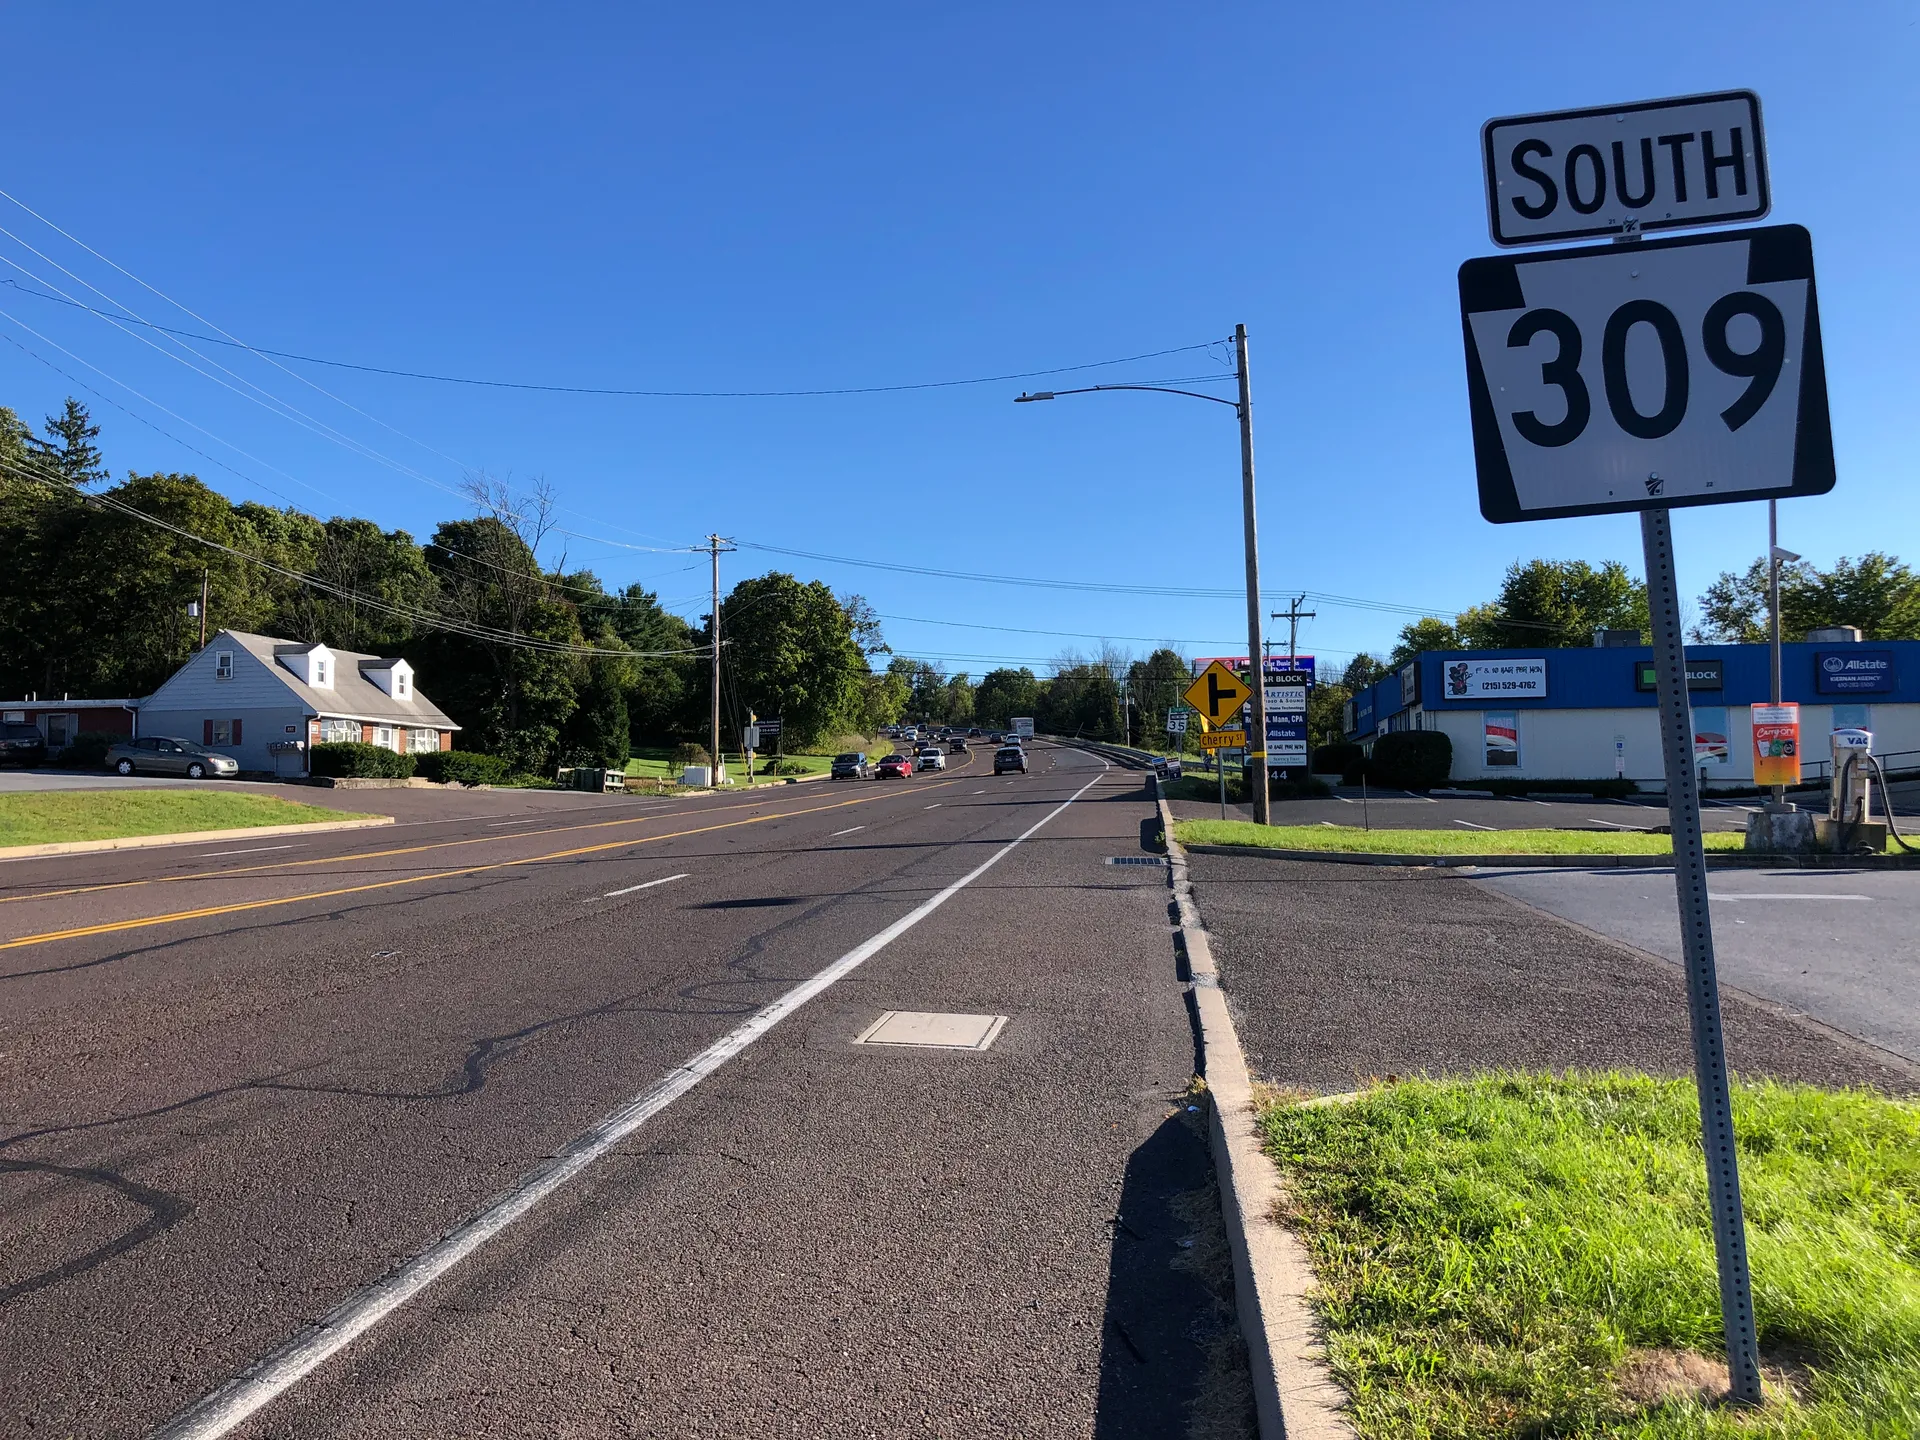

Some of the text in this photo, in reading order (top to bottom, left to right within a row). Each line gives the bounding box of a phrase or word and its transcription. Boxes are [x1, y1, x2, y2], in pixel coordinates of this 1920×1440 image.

[1510, 127, 1748, 220] SOUTH
[1506, 290, 1787, 448] 309
[1845, 659, 1888, 670] Allstate
[1276, 675, 1303, 683] BLOCK
[1685, 671, 1717, 679] BLOCK
[1482, 681, 1537, 690] (215) 529-4762
[1264, 689, 1304, 698] ARTISTIC
[1272, 715, 1291, 724] Mann,
[1291, 715, 1304, 723] CPA
[1168, 721, 1185, 731] 35
[1201, 735, 1234, 747] Cherry
[1847, 737, 1868, 745] VAC
